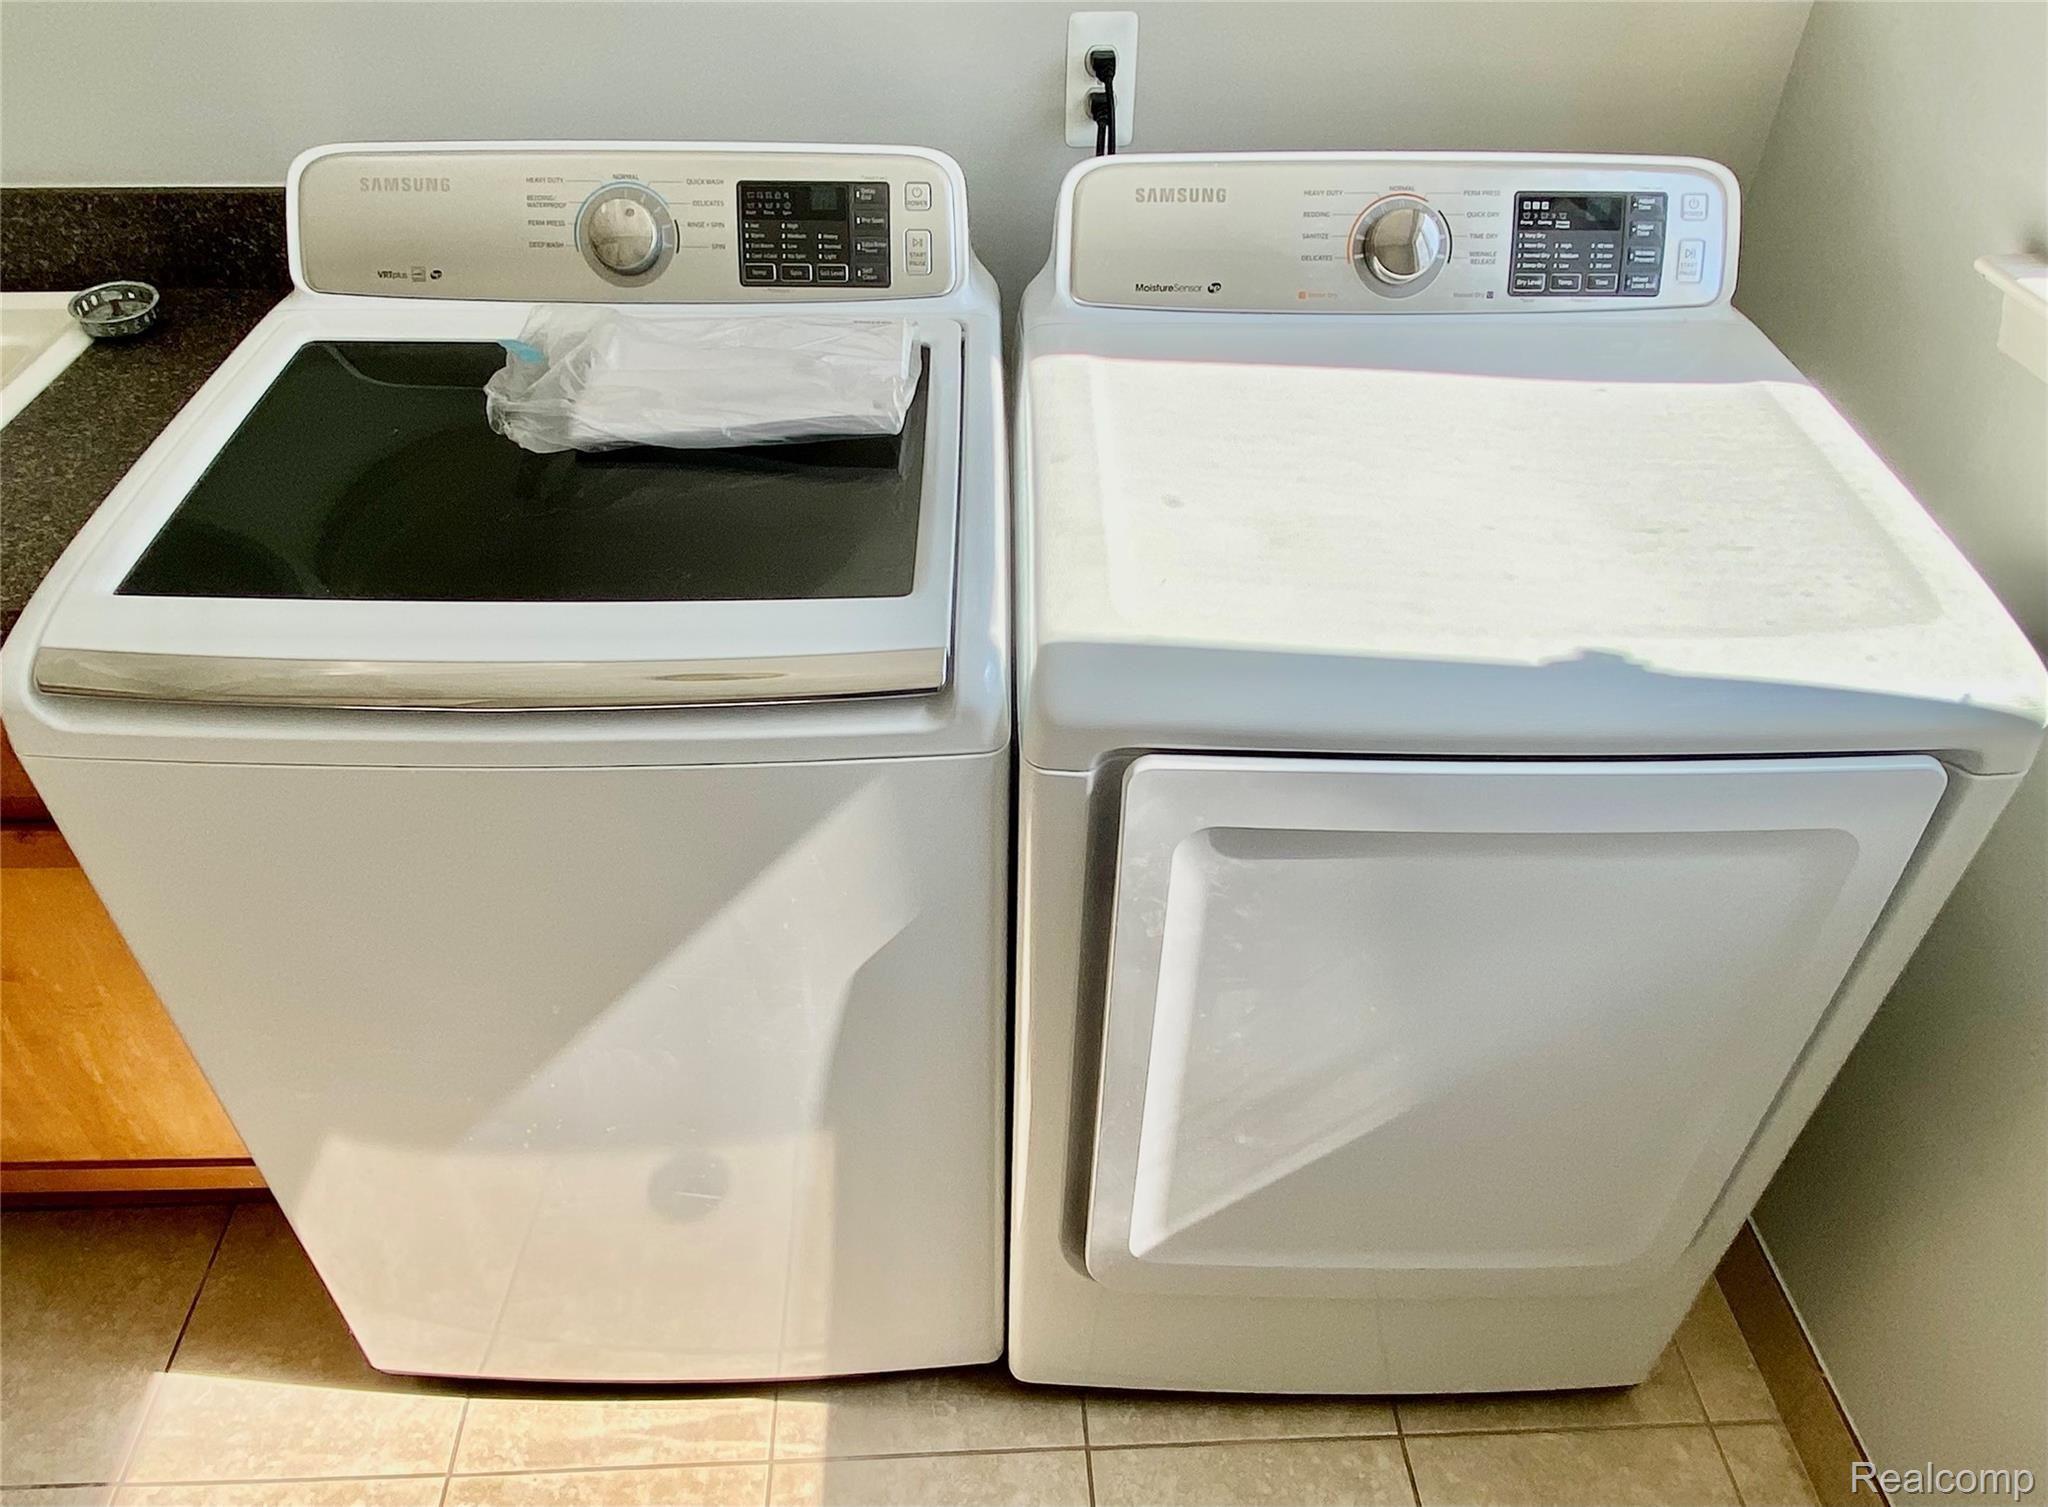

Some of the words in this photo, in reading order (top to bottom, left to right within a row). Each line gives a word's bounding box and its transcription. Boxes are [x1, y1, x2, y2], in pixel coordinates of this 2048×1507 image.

[360, 177, 451, 192] SAMSUNG
[1135, 187, 1227, 203] SAMSUNG
[1135, 283, 1203, 293] MoistureSensor
